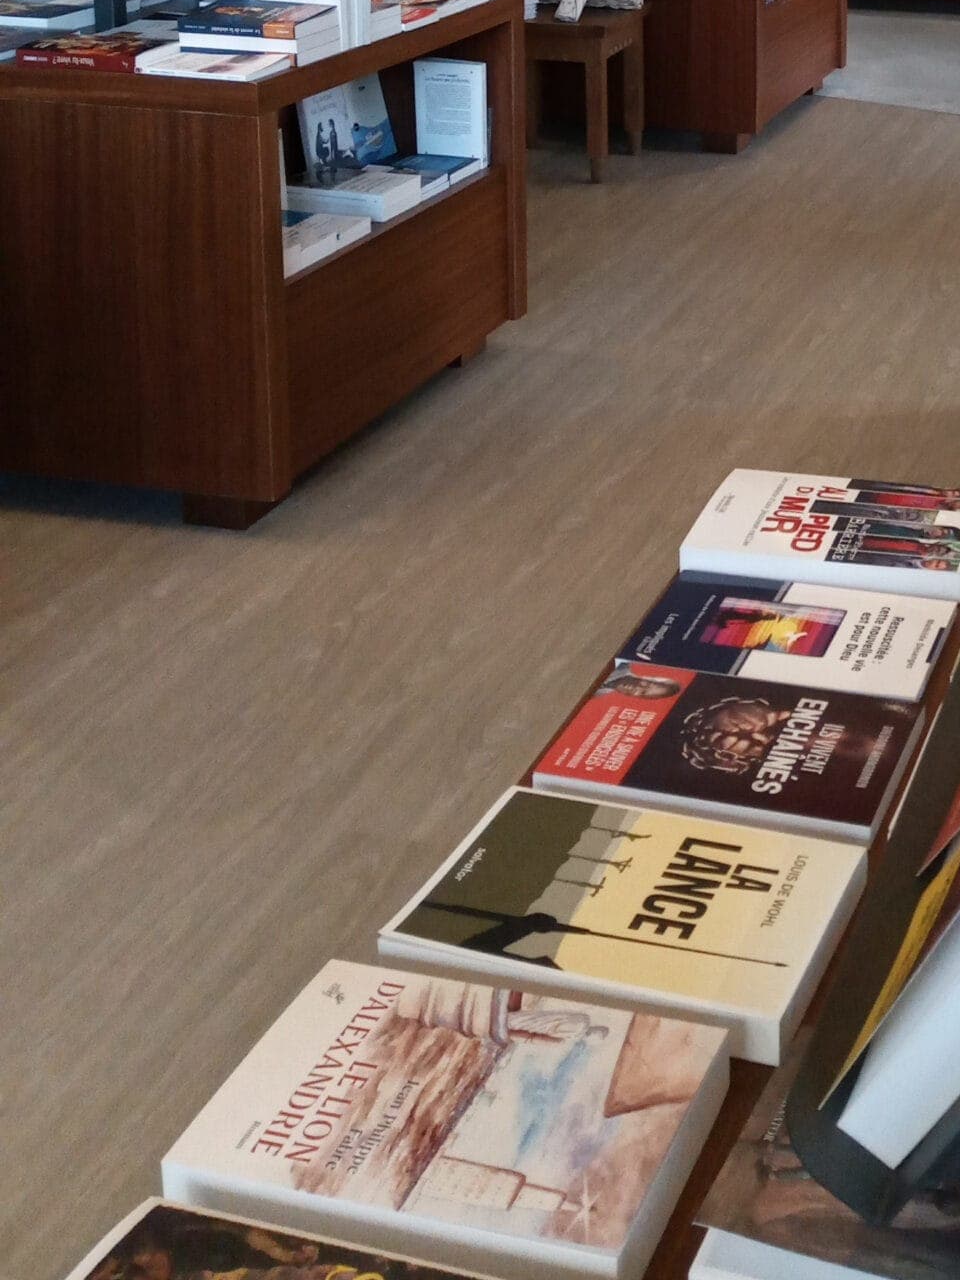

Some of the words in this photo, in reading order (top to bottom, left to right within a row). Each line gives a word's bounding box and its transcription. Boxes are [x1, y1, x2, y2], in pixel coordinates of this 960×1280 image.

[816, 486, 848, 500] AU
[760, 495, 810, 534] MUR
[790, 515, 830, 553] PIED
[859, 611, 872, 625] est
[875, 606, 891, 625] cette
[849, 625, 867, 644] pour
[861, 626, 883, 658] nouvelle
[875, 617, 905, 661] Ressuscitée
[839, 643, 857, 663] Dieu
[851, 658, 866, 673] vie
[819, 723, 846, 739] ILS
[603, 744, 636, 772] SAUVER
[751, 697, 829, 796] ENCHAÎNÉS
[801, 740, 836, 775] VIVENT
[454, 847, 488, 883] salvator
[725, 863, 780, 893] LA
[792, 854, 810, 881] LOUIS
[628, 836, 743, 941] LANCE
[780, 881, 795, 899] DE
[760, 898, 787, 929] WOHL
[250, 981, 406, 1157] D'ALEXANDRIE
[337, 1060, 378, 1090] LE
[390, 1079, 420, 1109] Jean
[284, 1095, 353, 1165] LION
[346, 1112, 397, 1175] Philippe
[324, 1128, 364, 1171] Fabre
